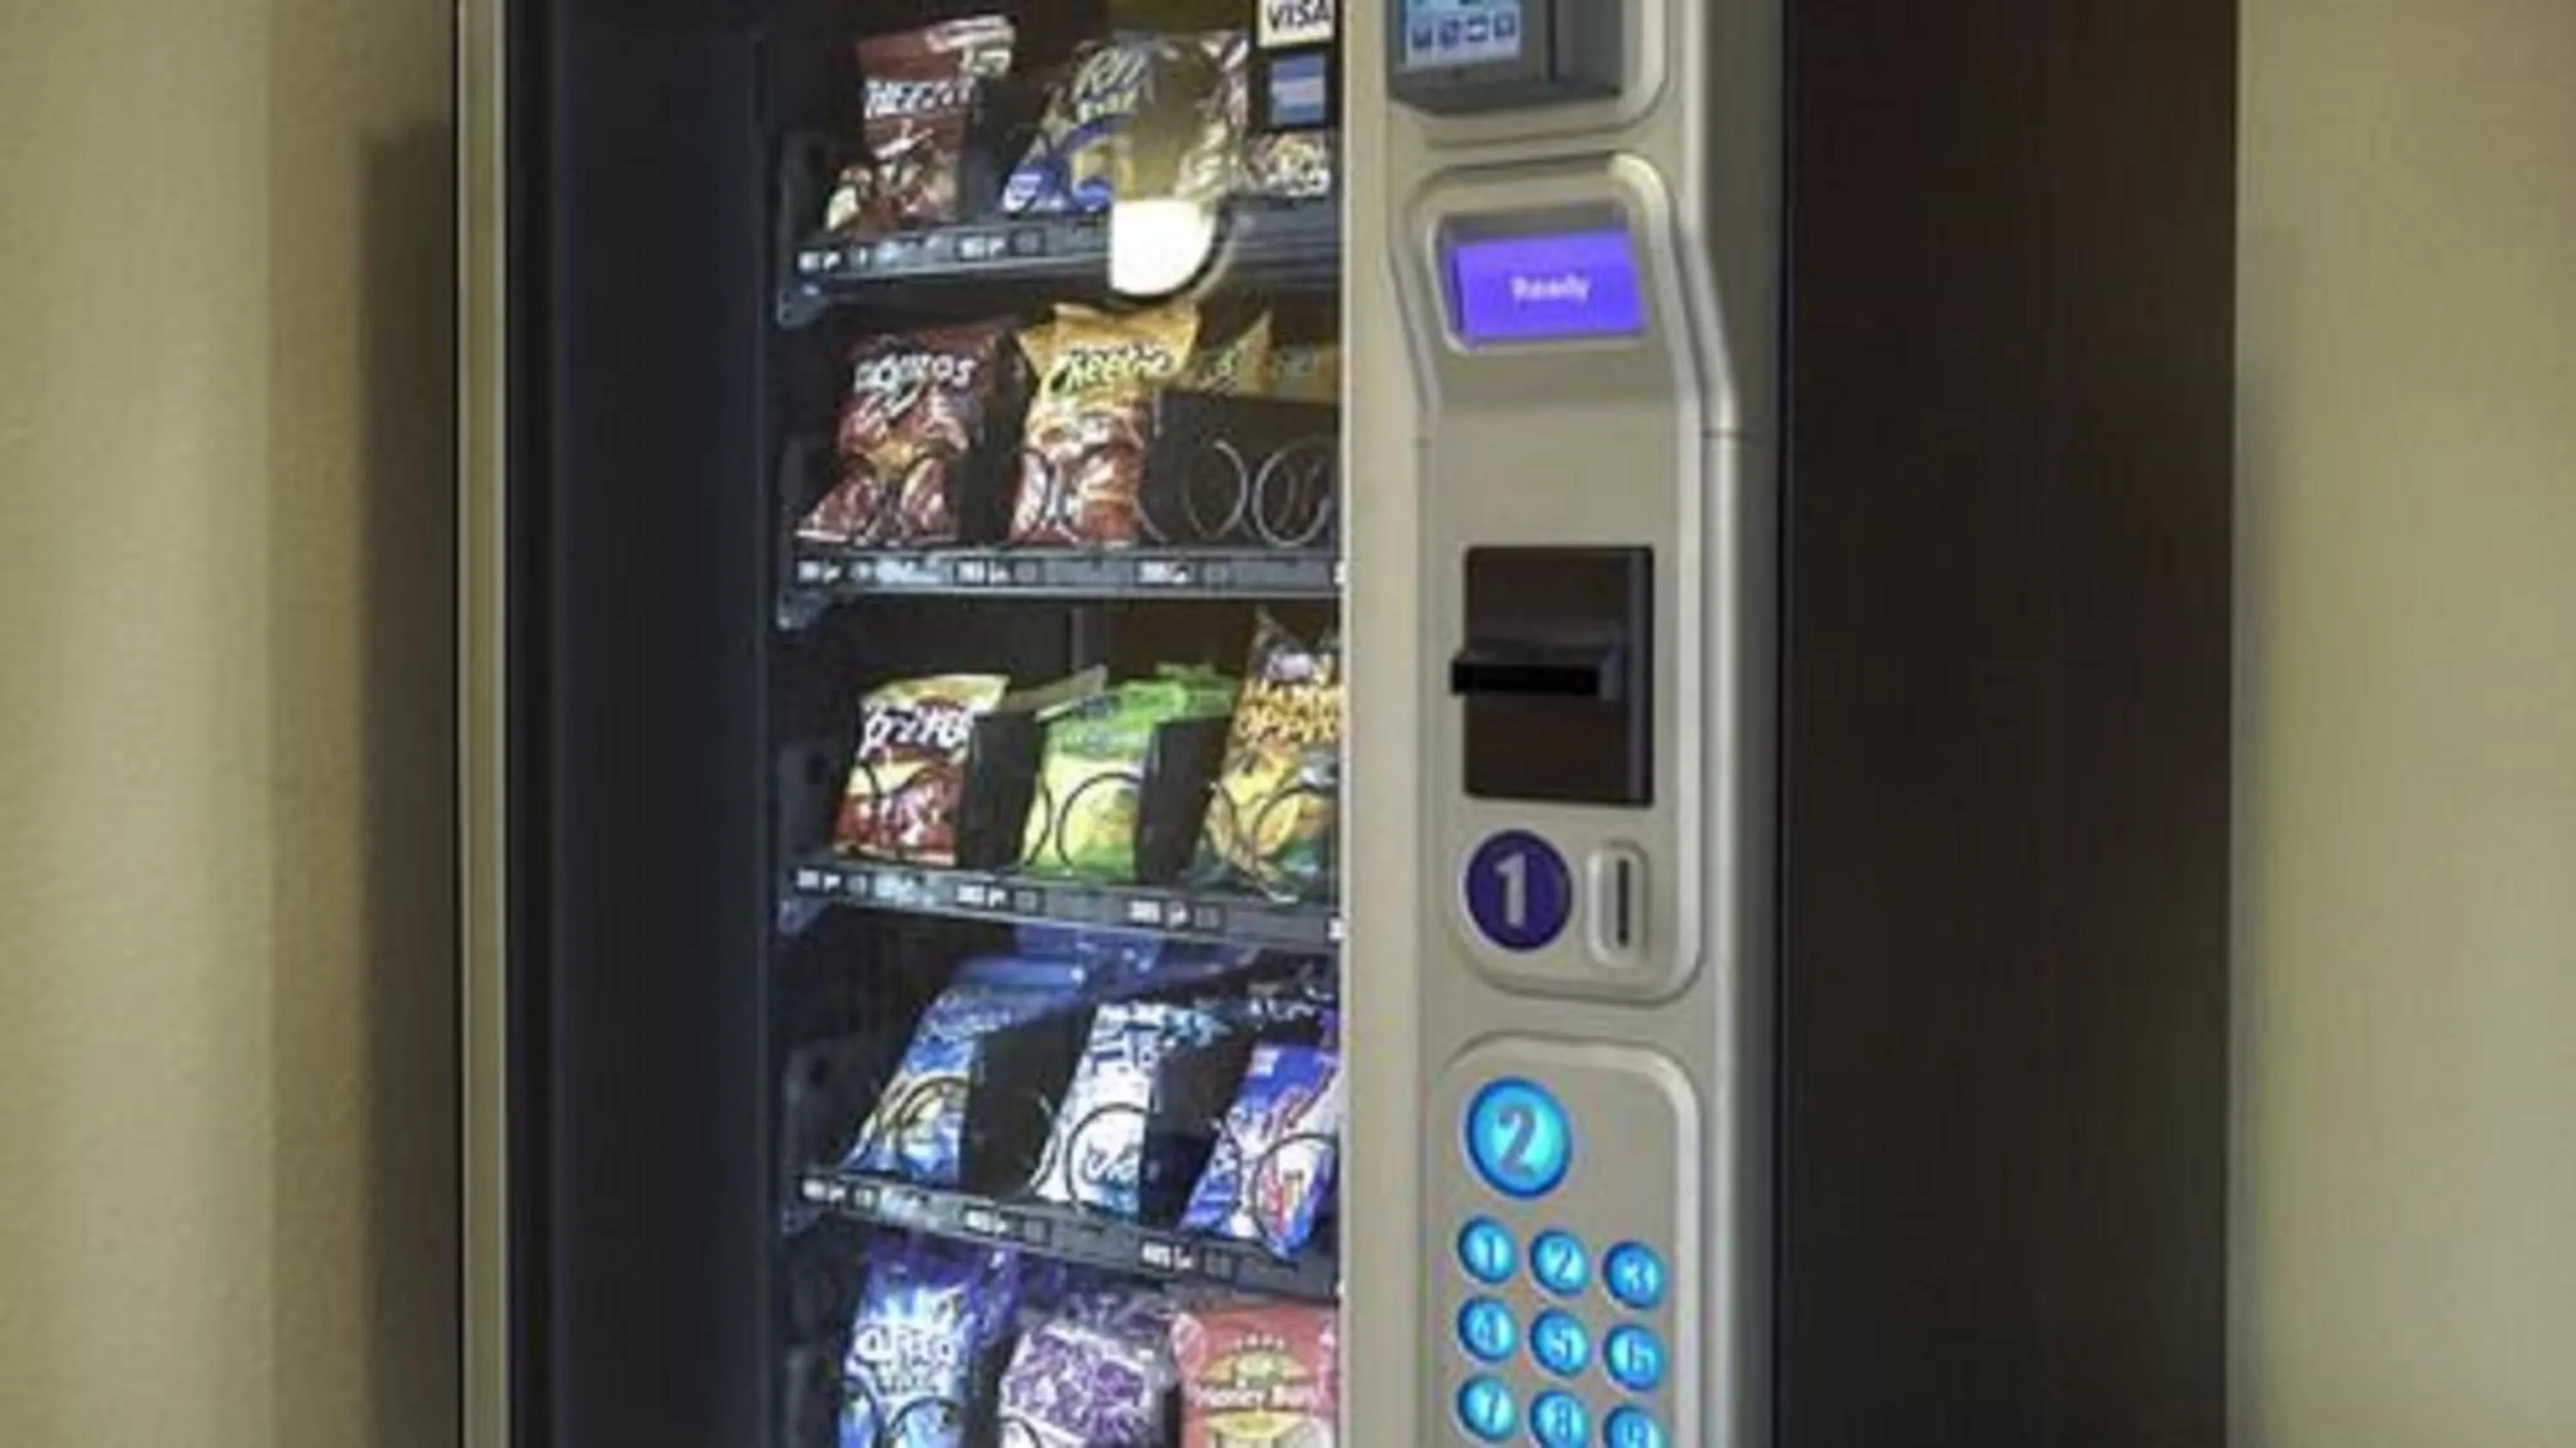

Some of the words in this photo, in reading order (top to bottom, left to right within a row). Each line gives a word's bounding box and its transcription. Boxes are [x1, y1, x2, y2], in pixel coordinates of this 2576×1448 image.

[1267, 0, 1331, 31] VISA
[1511, 275, 1589, 305] Ready
[1493, 852, 1527, 928] 1
[1494, 1104, 1537, 1178] 2
[1549, 1238, 1573, 1282] 2
[1625, 1250, 1649, 1296] 3
[1550, 1323, 1574, 1367] 5
[1625, 1336, 1653, 1379] 6
